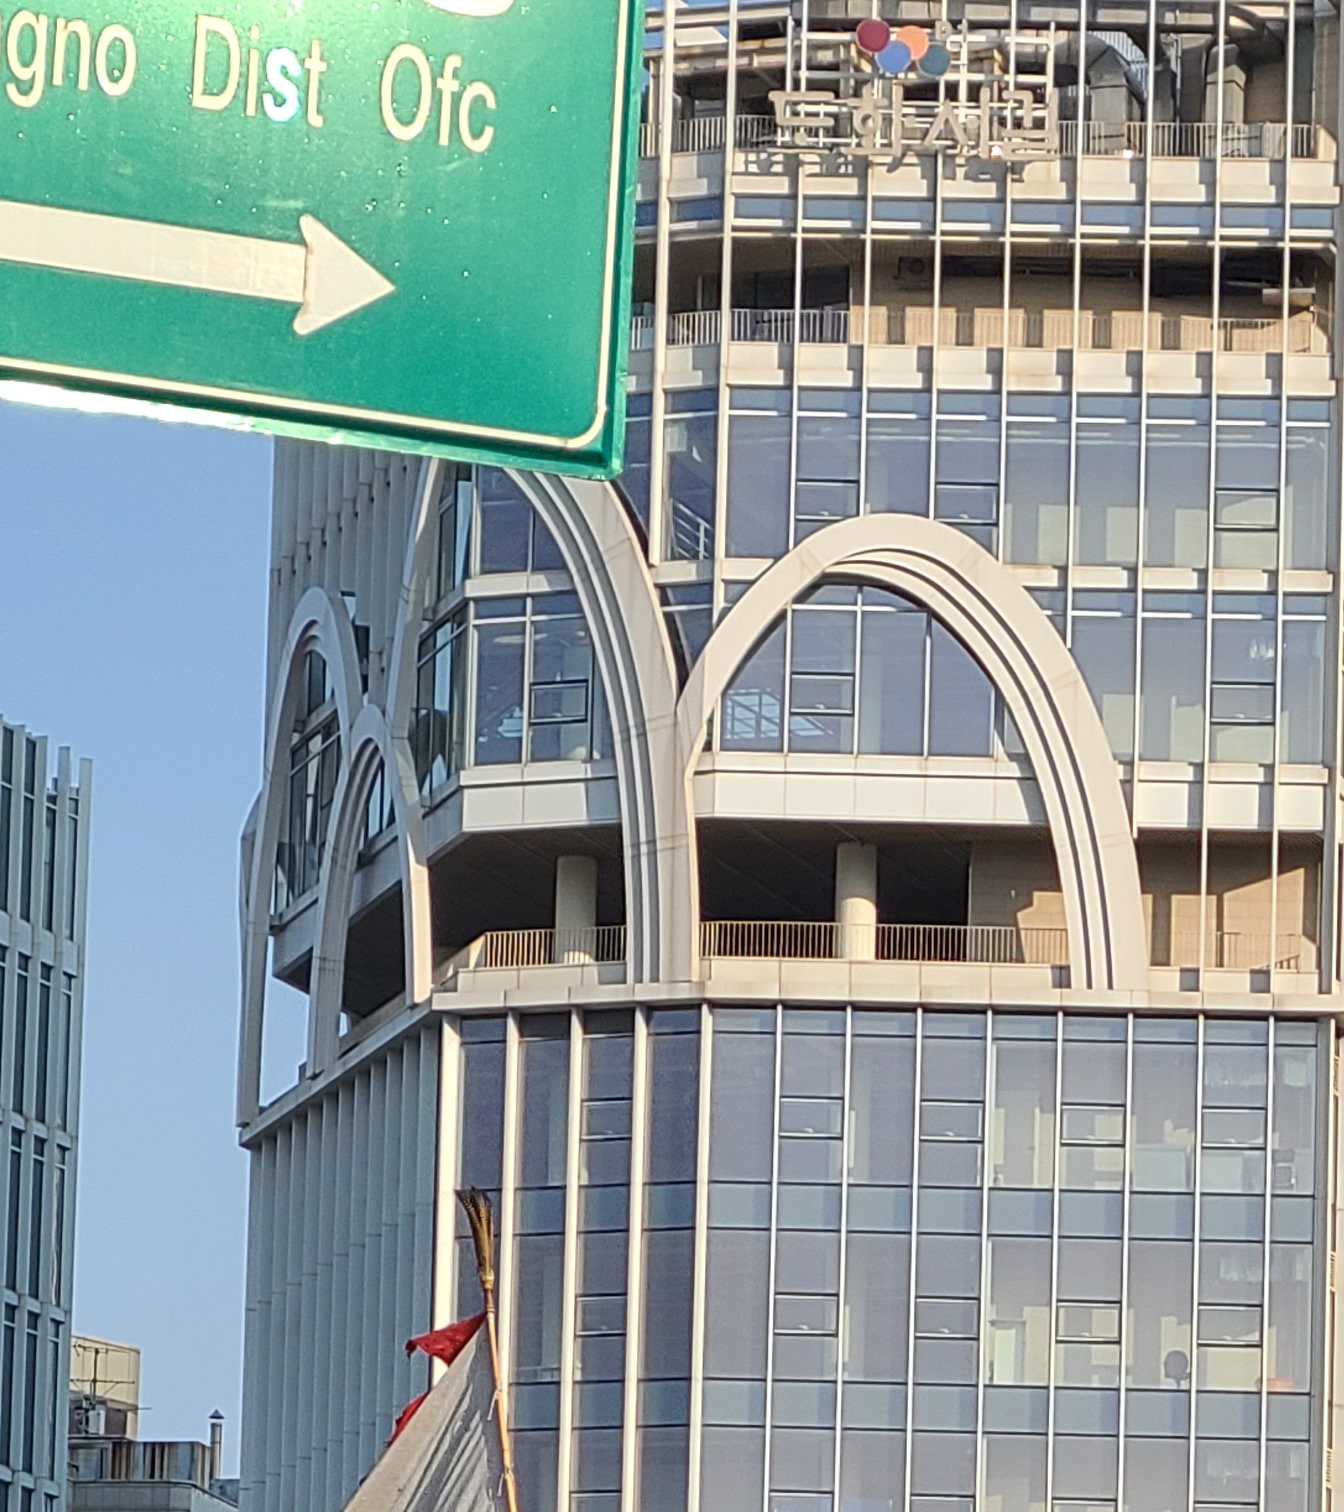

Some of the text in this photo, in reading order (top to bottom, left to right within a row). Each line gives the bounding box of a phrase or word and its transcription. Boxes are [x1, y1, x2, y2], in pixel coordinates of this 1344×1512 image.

[191, 14, 328, 129] Dist
[380, 42, 497, 154] Ofc
[767, 84, 1060, 162] 도화서길
